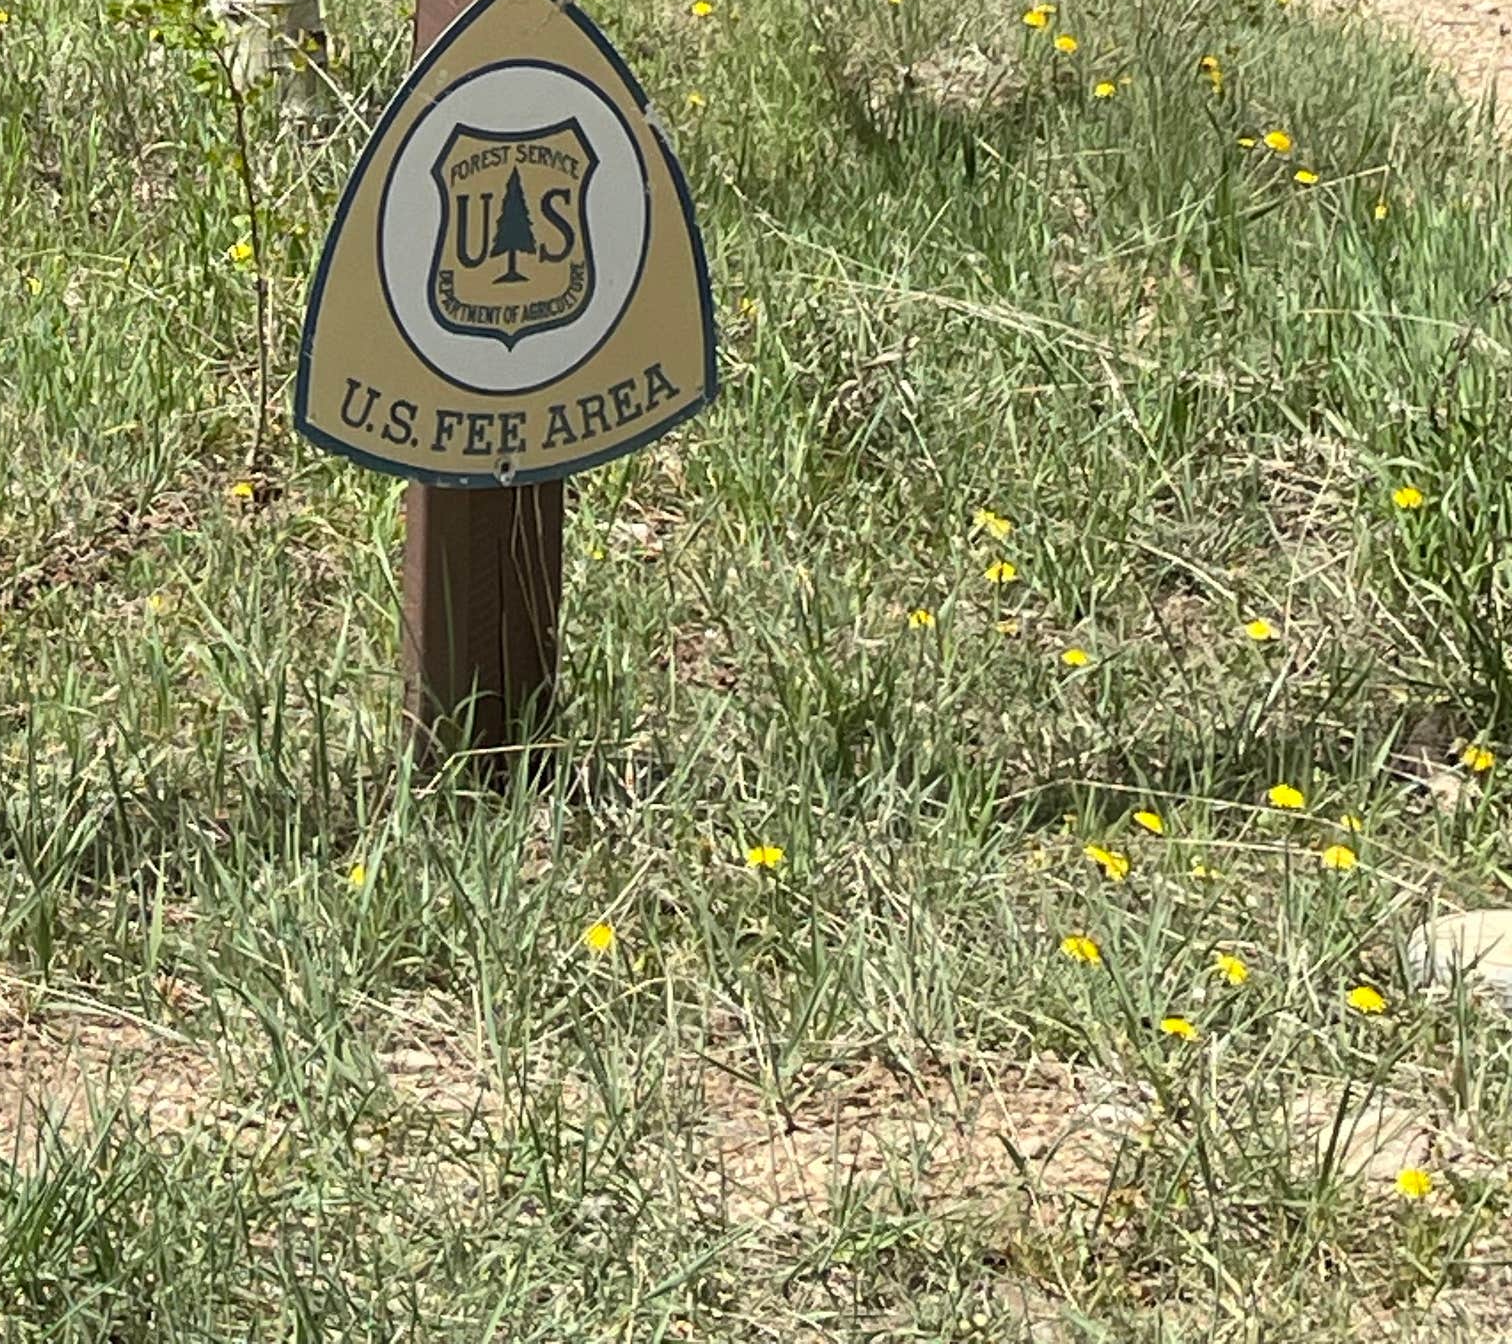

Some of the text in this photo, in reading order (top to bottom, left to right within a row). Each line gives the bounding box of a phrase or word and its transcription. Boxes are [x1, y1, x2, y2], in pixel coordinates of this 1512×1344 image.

[451, 144, 580, 188] FOREST SERVICE
[340, 363, 680, 456] U.S. FEE AREA
